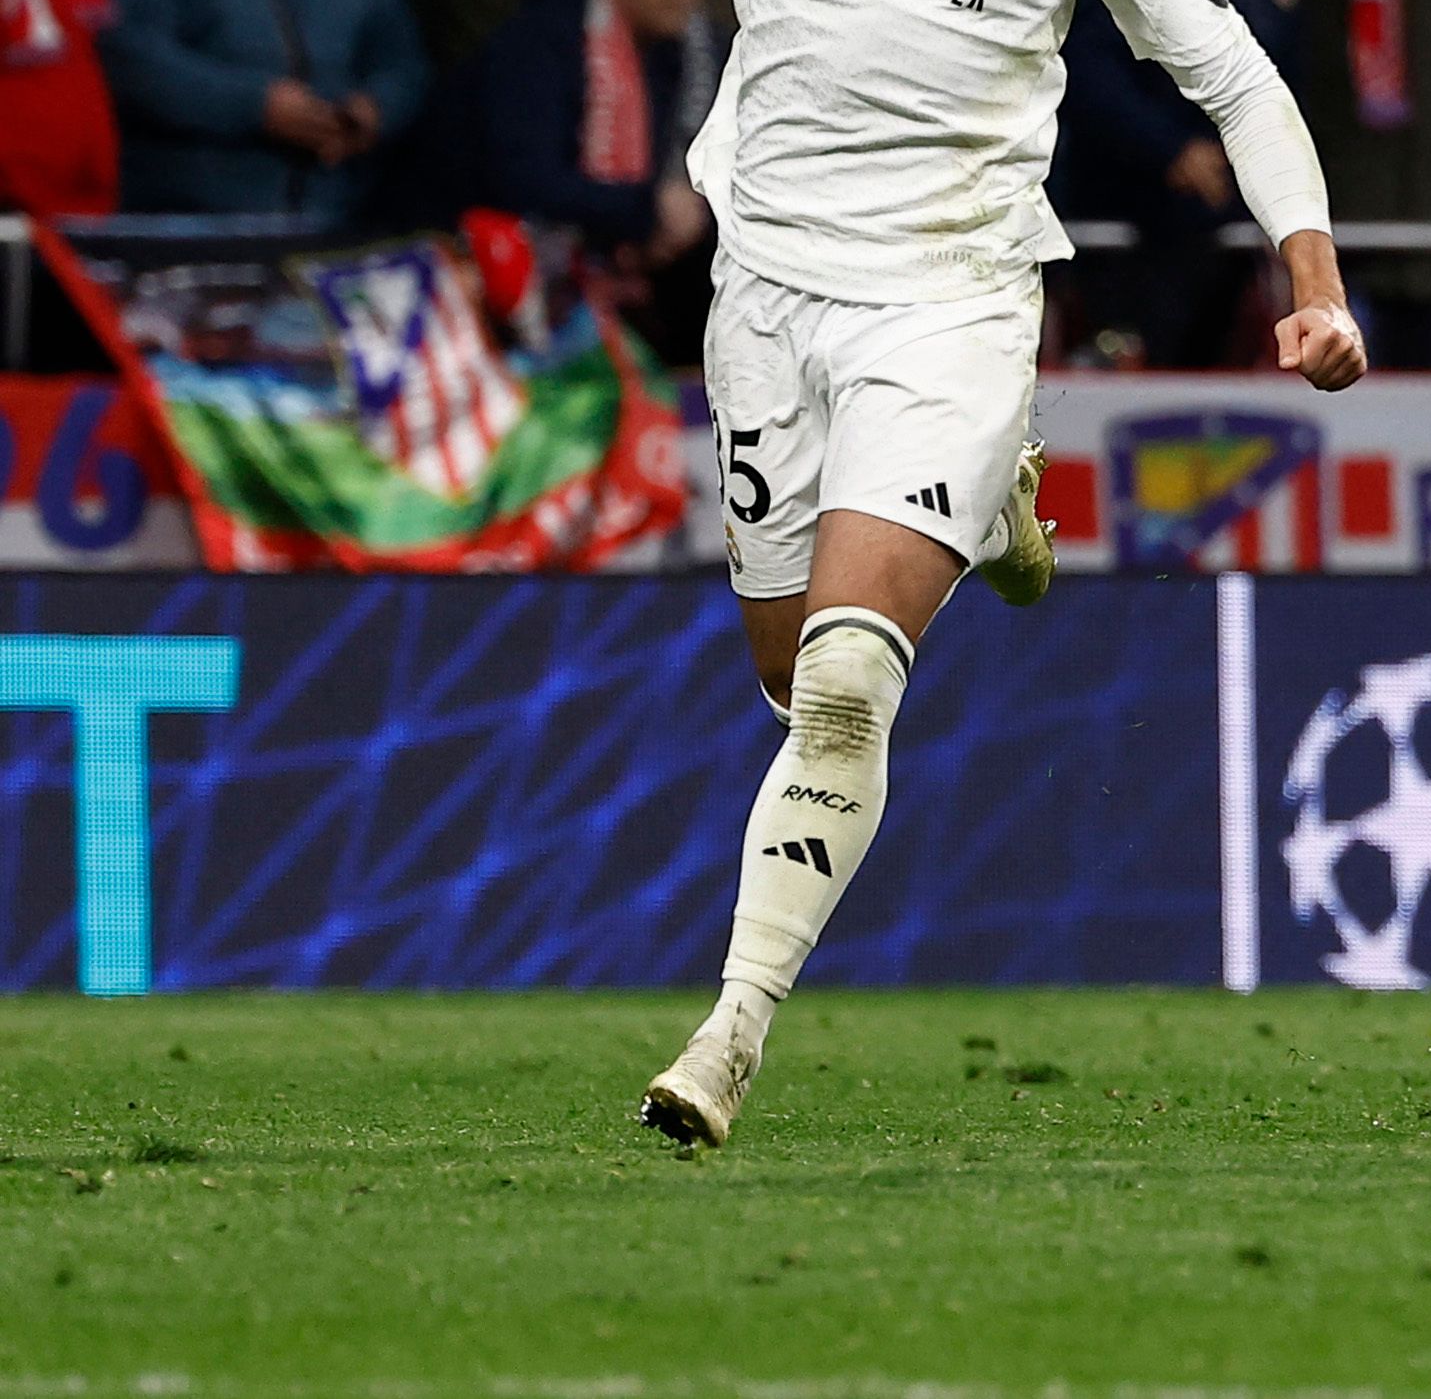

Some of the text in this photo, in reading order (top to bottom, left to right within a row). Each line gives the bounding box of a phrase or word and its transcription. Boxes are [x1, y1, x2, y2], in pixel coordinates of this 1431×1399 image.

[713, 408, 771, 524] 5
[0, 635, 241, 996] T
[780, 784, 862, 814] RMCF
